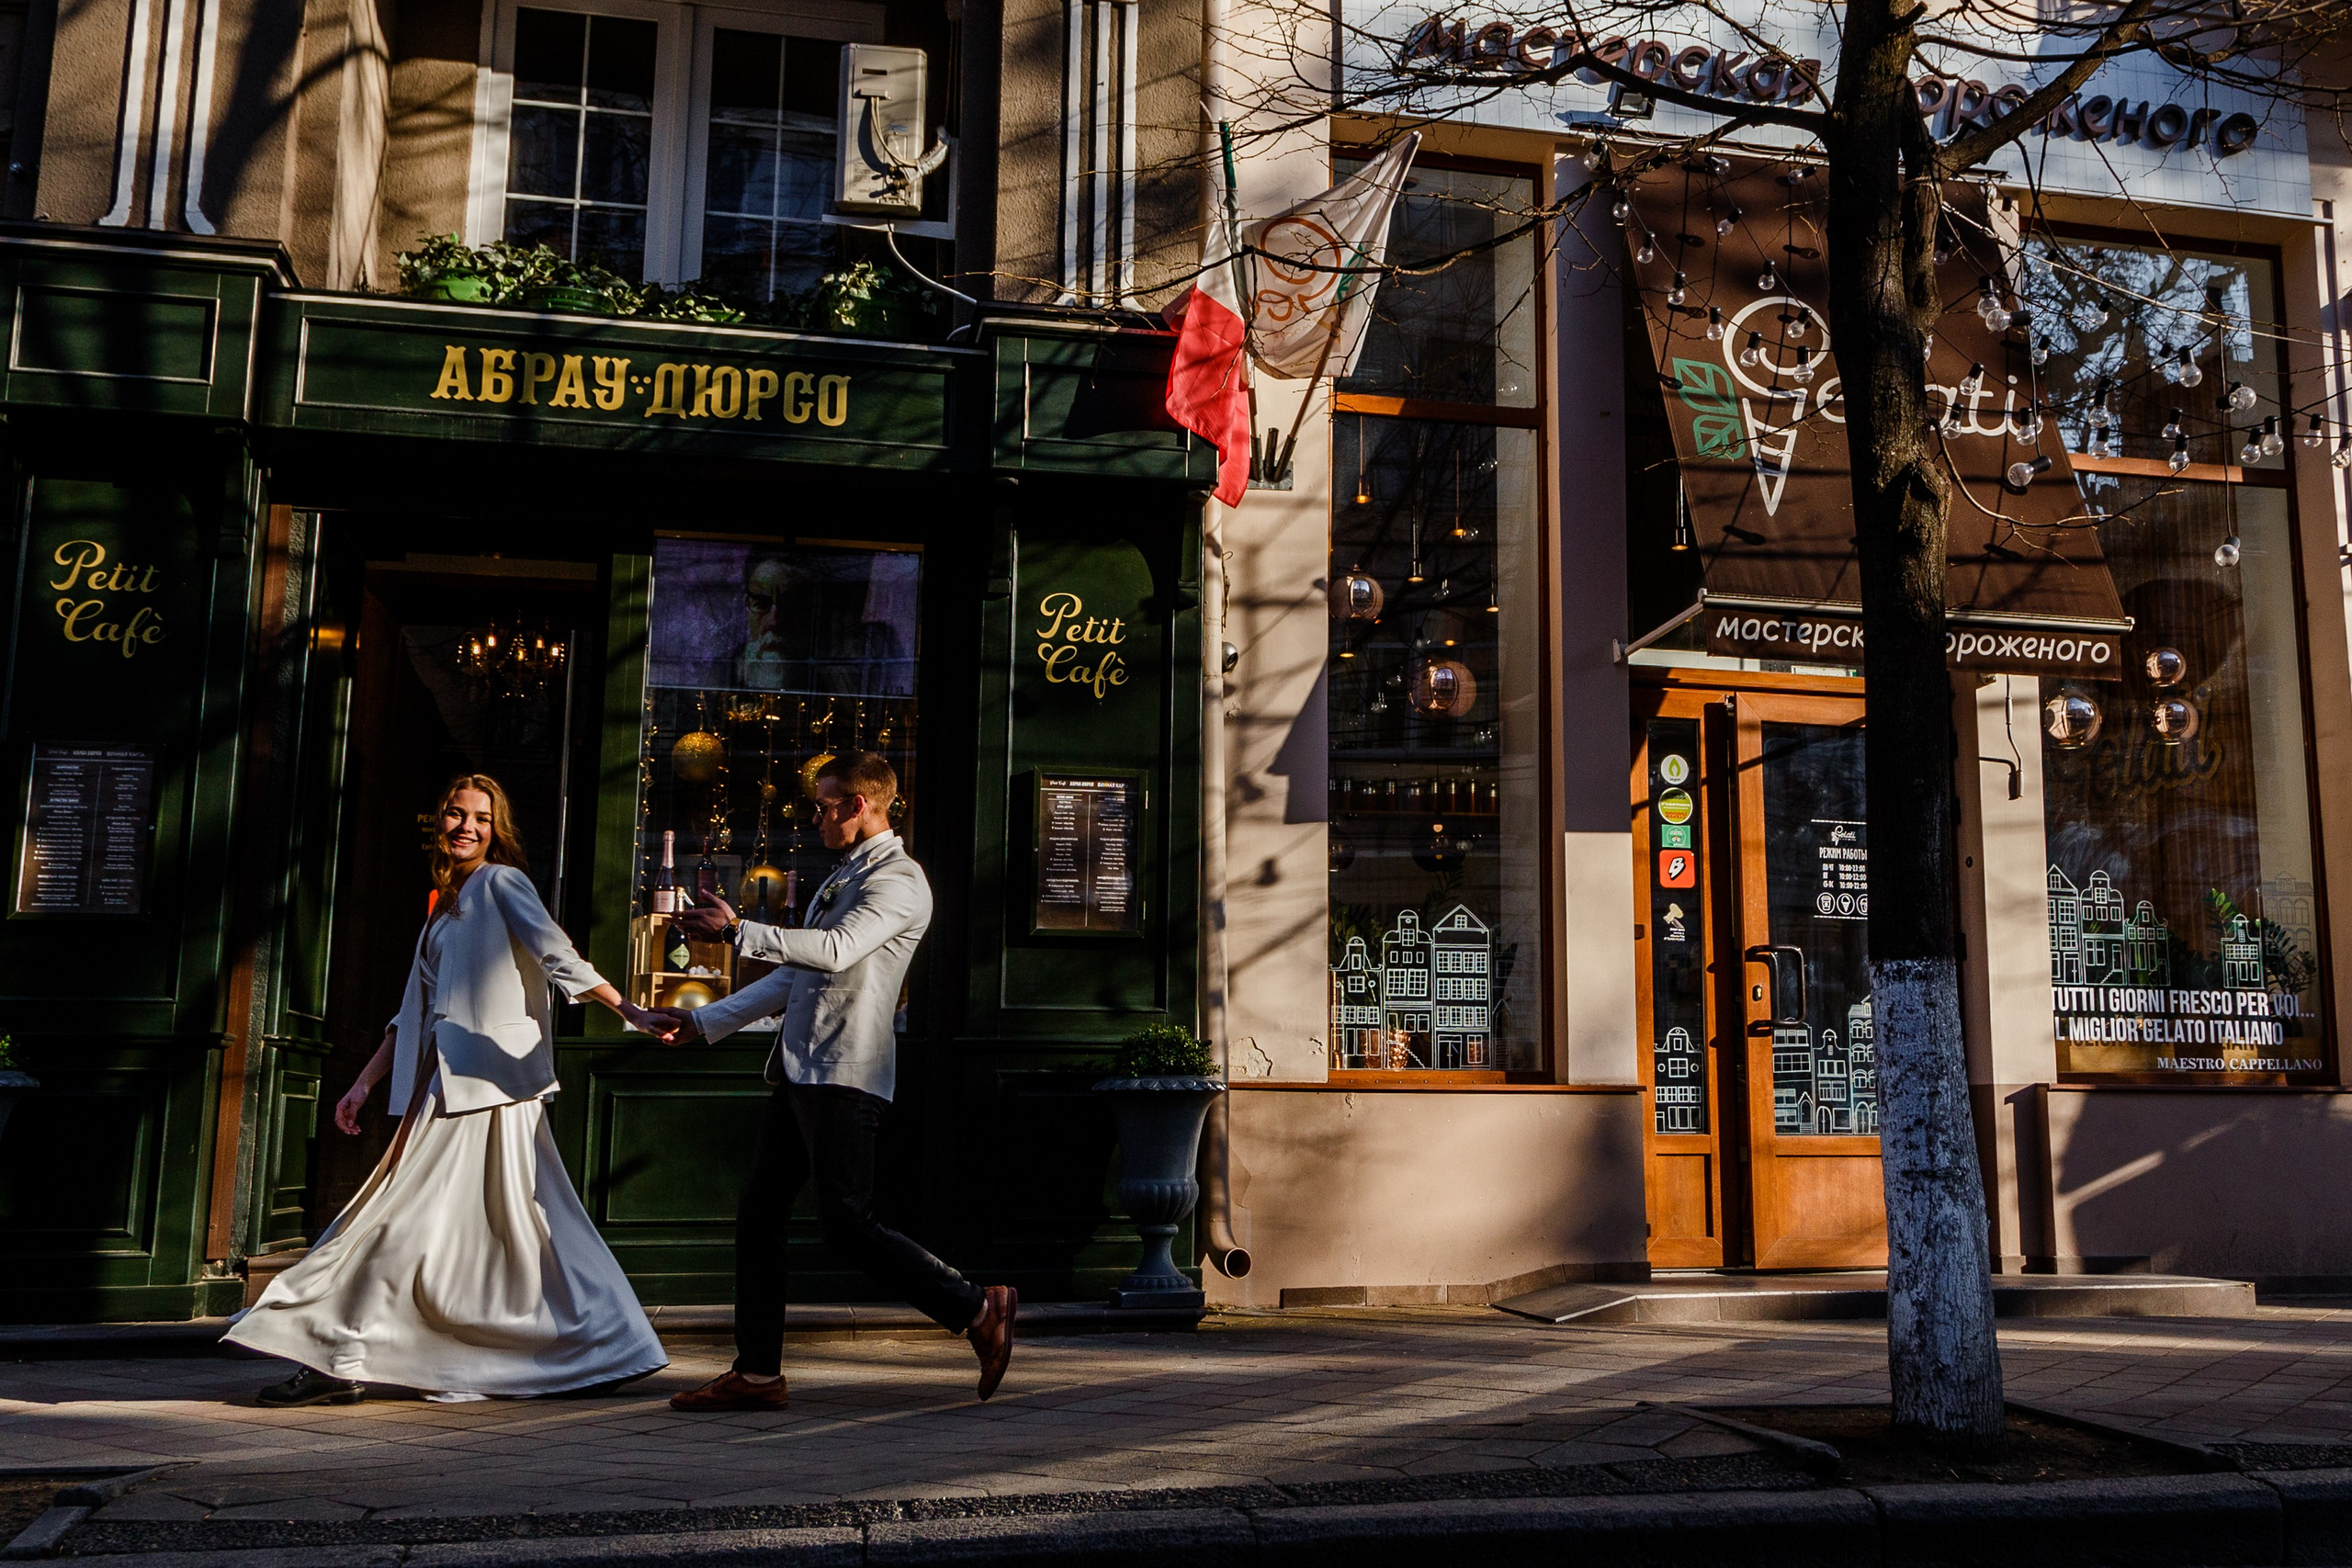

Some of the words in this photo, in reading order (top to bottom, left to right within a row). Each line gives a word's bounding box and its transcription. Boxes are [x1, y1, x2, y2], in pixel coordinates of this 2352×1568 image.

[1410, 14, 1821, 103] мастерская
[1914, 74, 2258, 156] ороженого
[429, 344, 632, 411] АБРАУ
[644, 362, 853, 427] ДЮРСО
[1723, 296, 2042, 473] Geati
[51, 540, 161, 592] Petit
[1036, 592, 1126, 644] Petit
[1716, 616, 1864, 653] мастерск
[1819, 847, 1841, 859] РЕЖИМ
[1842, 848, 1868, 861] РАБОТЫ
[2051, 987, 2095, 1011] TUTTI
[2099, 987, 2105, 1011] I
[2109, 987, 2165, 1013] GIORNI
[2169, 989, 2233, 1015] FRESCO
[2236, 991, 2269, 1016] PER
[2054, 1016, 2065, 1041] L
[2068, 1017, 2139, 1043] MIGLIOR
[2143, 1018, 2206, 1043] GELATO
[2209, 1020, 2283, 1045] ITALIANO
[2157, 1056, 2225, 1070] MAESTRO
[2229, 1057, 2323, 1071] CAPPELLANO
